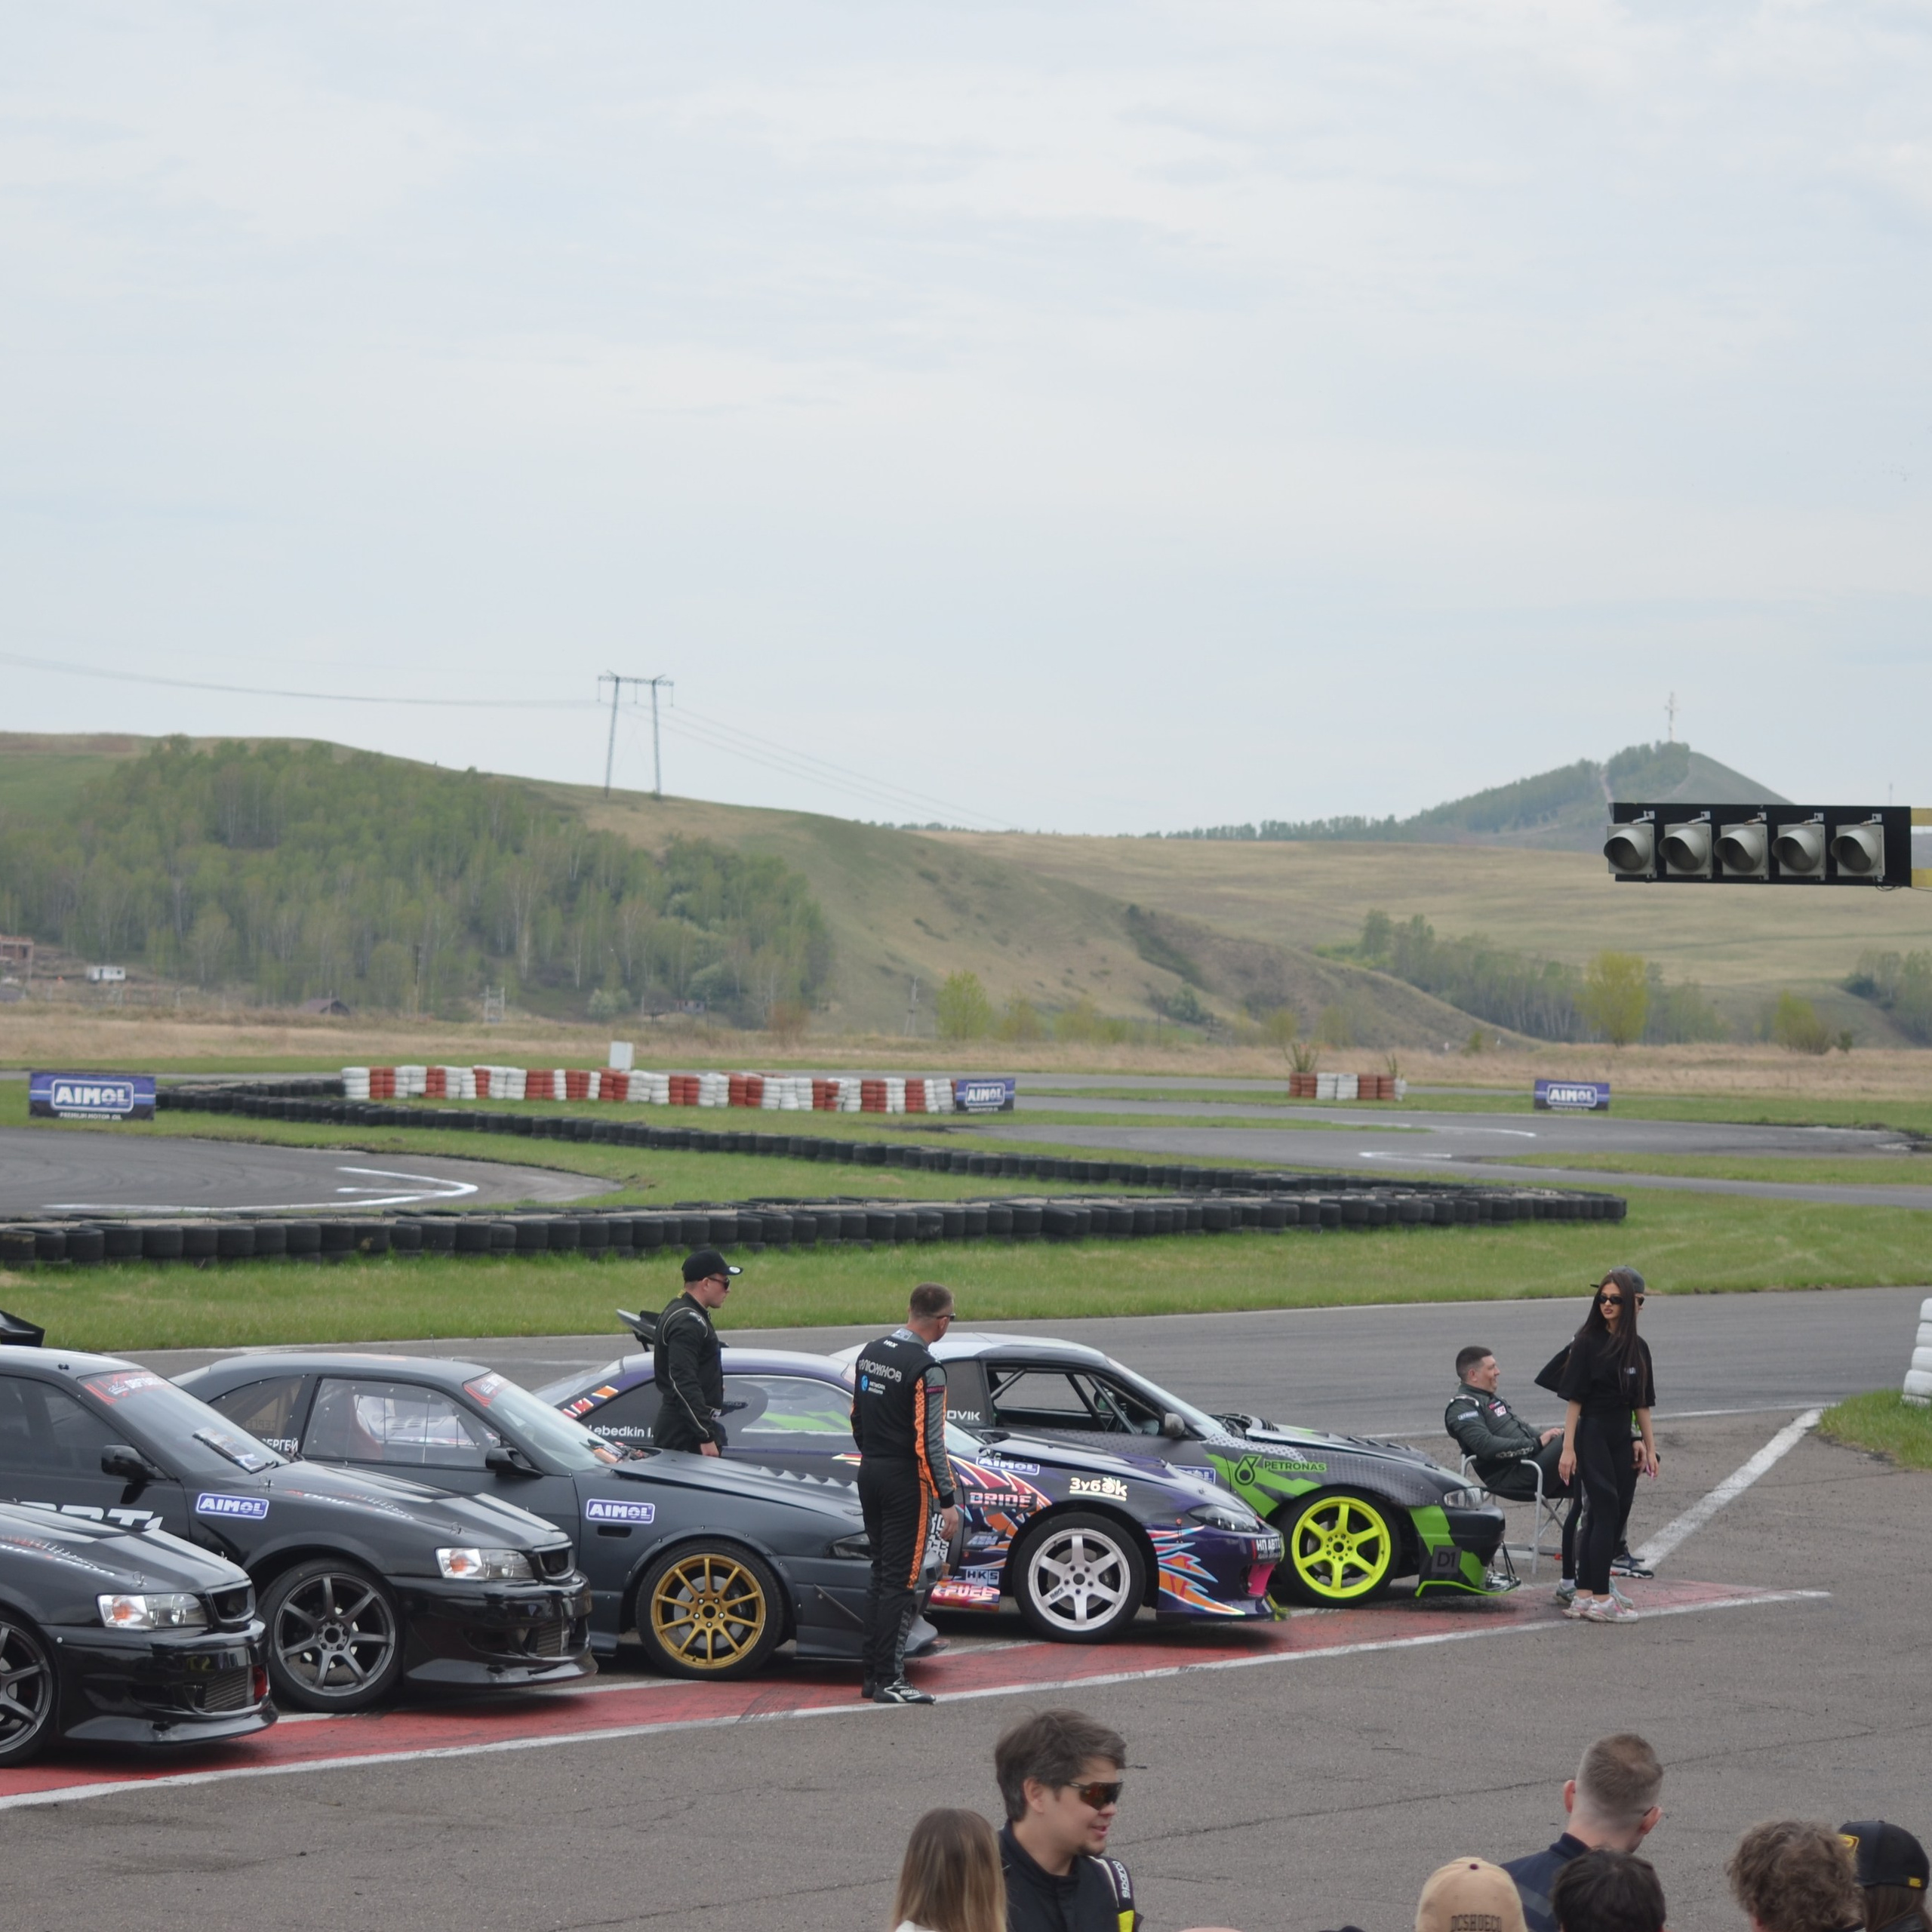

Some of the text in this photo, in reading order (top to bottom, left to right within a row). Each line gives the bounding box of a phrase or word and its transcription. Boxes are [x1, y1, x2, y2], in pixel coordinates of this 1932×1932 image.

[55, 1086, 129, 1106] AIMOL
[968, 1088, 1002, 1101] AIMOL
[1549, 1089, 1593, 1102] AIMOL
[1264, 1460, 1325, 1471] PETRONAS
[200, 1497, 263, 1515] AIMOL
[589, 1503, 651, 1519] AIMOL
[1437, 1552, 1457, 1567] D1
[967, 1571, 999, 1580] HKS
[1112, 1860, 1131, 1900] sparco
